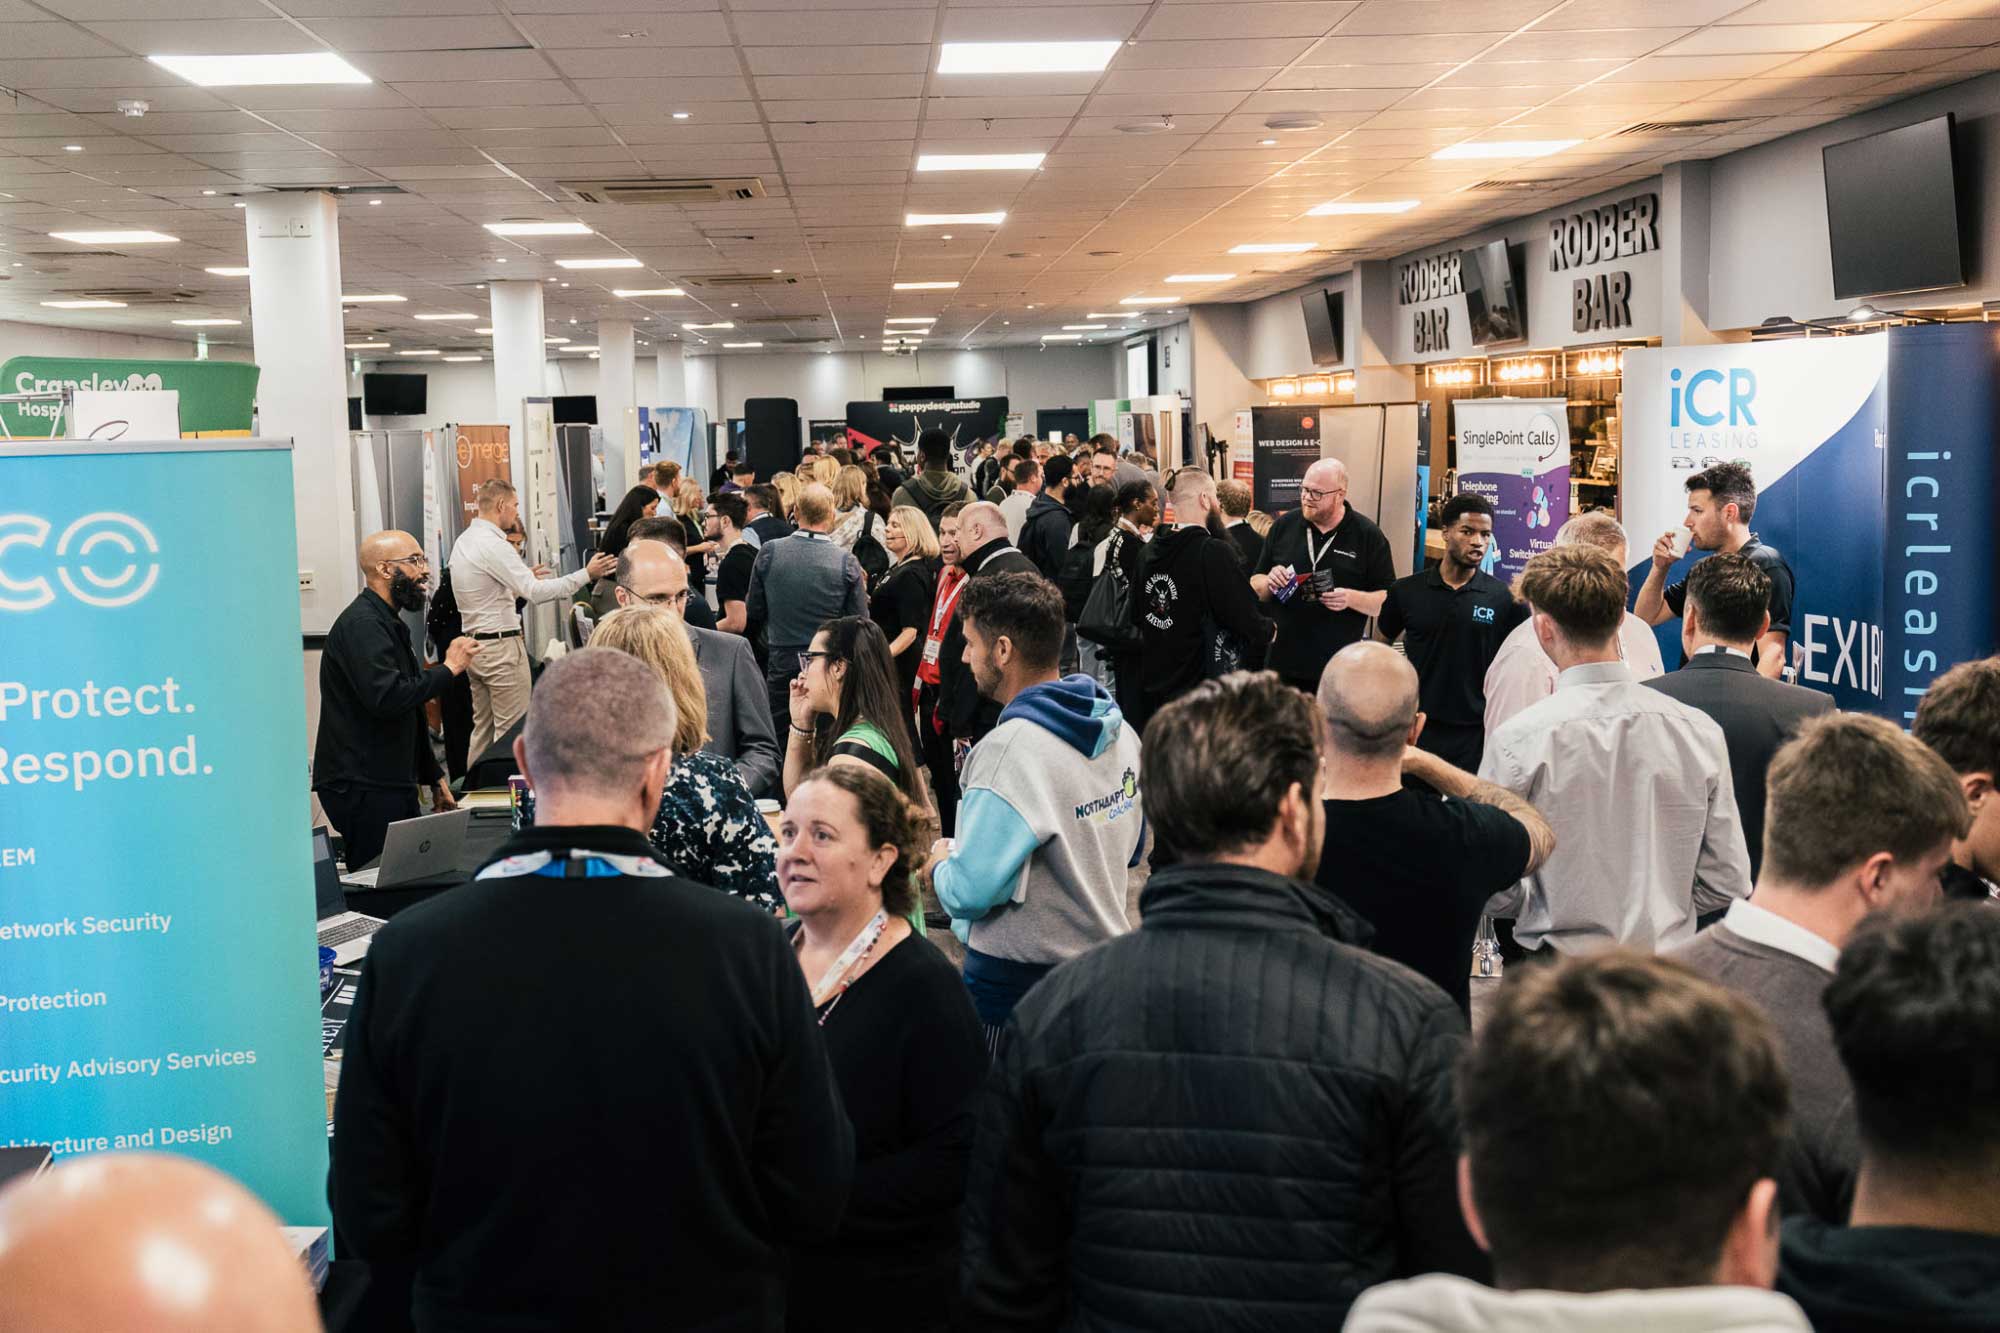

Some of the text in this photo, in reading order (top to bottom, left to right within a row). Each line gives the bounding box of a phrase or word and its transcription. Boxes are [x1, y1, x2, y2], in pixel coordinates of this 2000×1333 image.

[1550, 192, 1660, 272] RODBER
[1398, 249, 1465, 305] RODBER
[1572, 271, 1633, 334] BAR
[1413, 306, 1449, 354] BAR
[1671, 368, 1757, 427] iCR
[18, 402, 63, 422] Hosp
[1258, 439, 1275, 447] WEB
[1275, 439, 1303, 447] DESIGN
[1463, 430, 1555, 448] SinglePoint Calls
[1671, 432, 1759, 448] LEASING
[1461, 480, 1498, 494] Telephone
[1904, 451, 1951, 734] icrleasi
[1473, 604, 1495, 620] iCR
[0, 676, 196, 722] Protect.
[0, 847, 36, 868] EM
[82, 912, 172, 934] Security
[66, 1056, 161, 1078] Advisory
[167, 1048, 257, 1071] Services
[114, 1128, 154, 1148] and
[161, 1123, 233, 1146] Design
